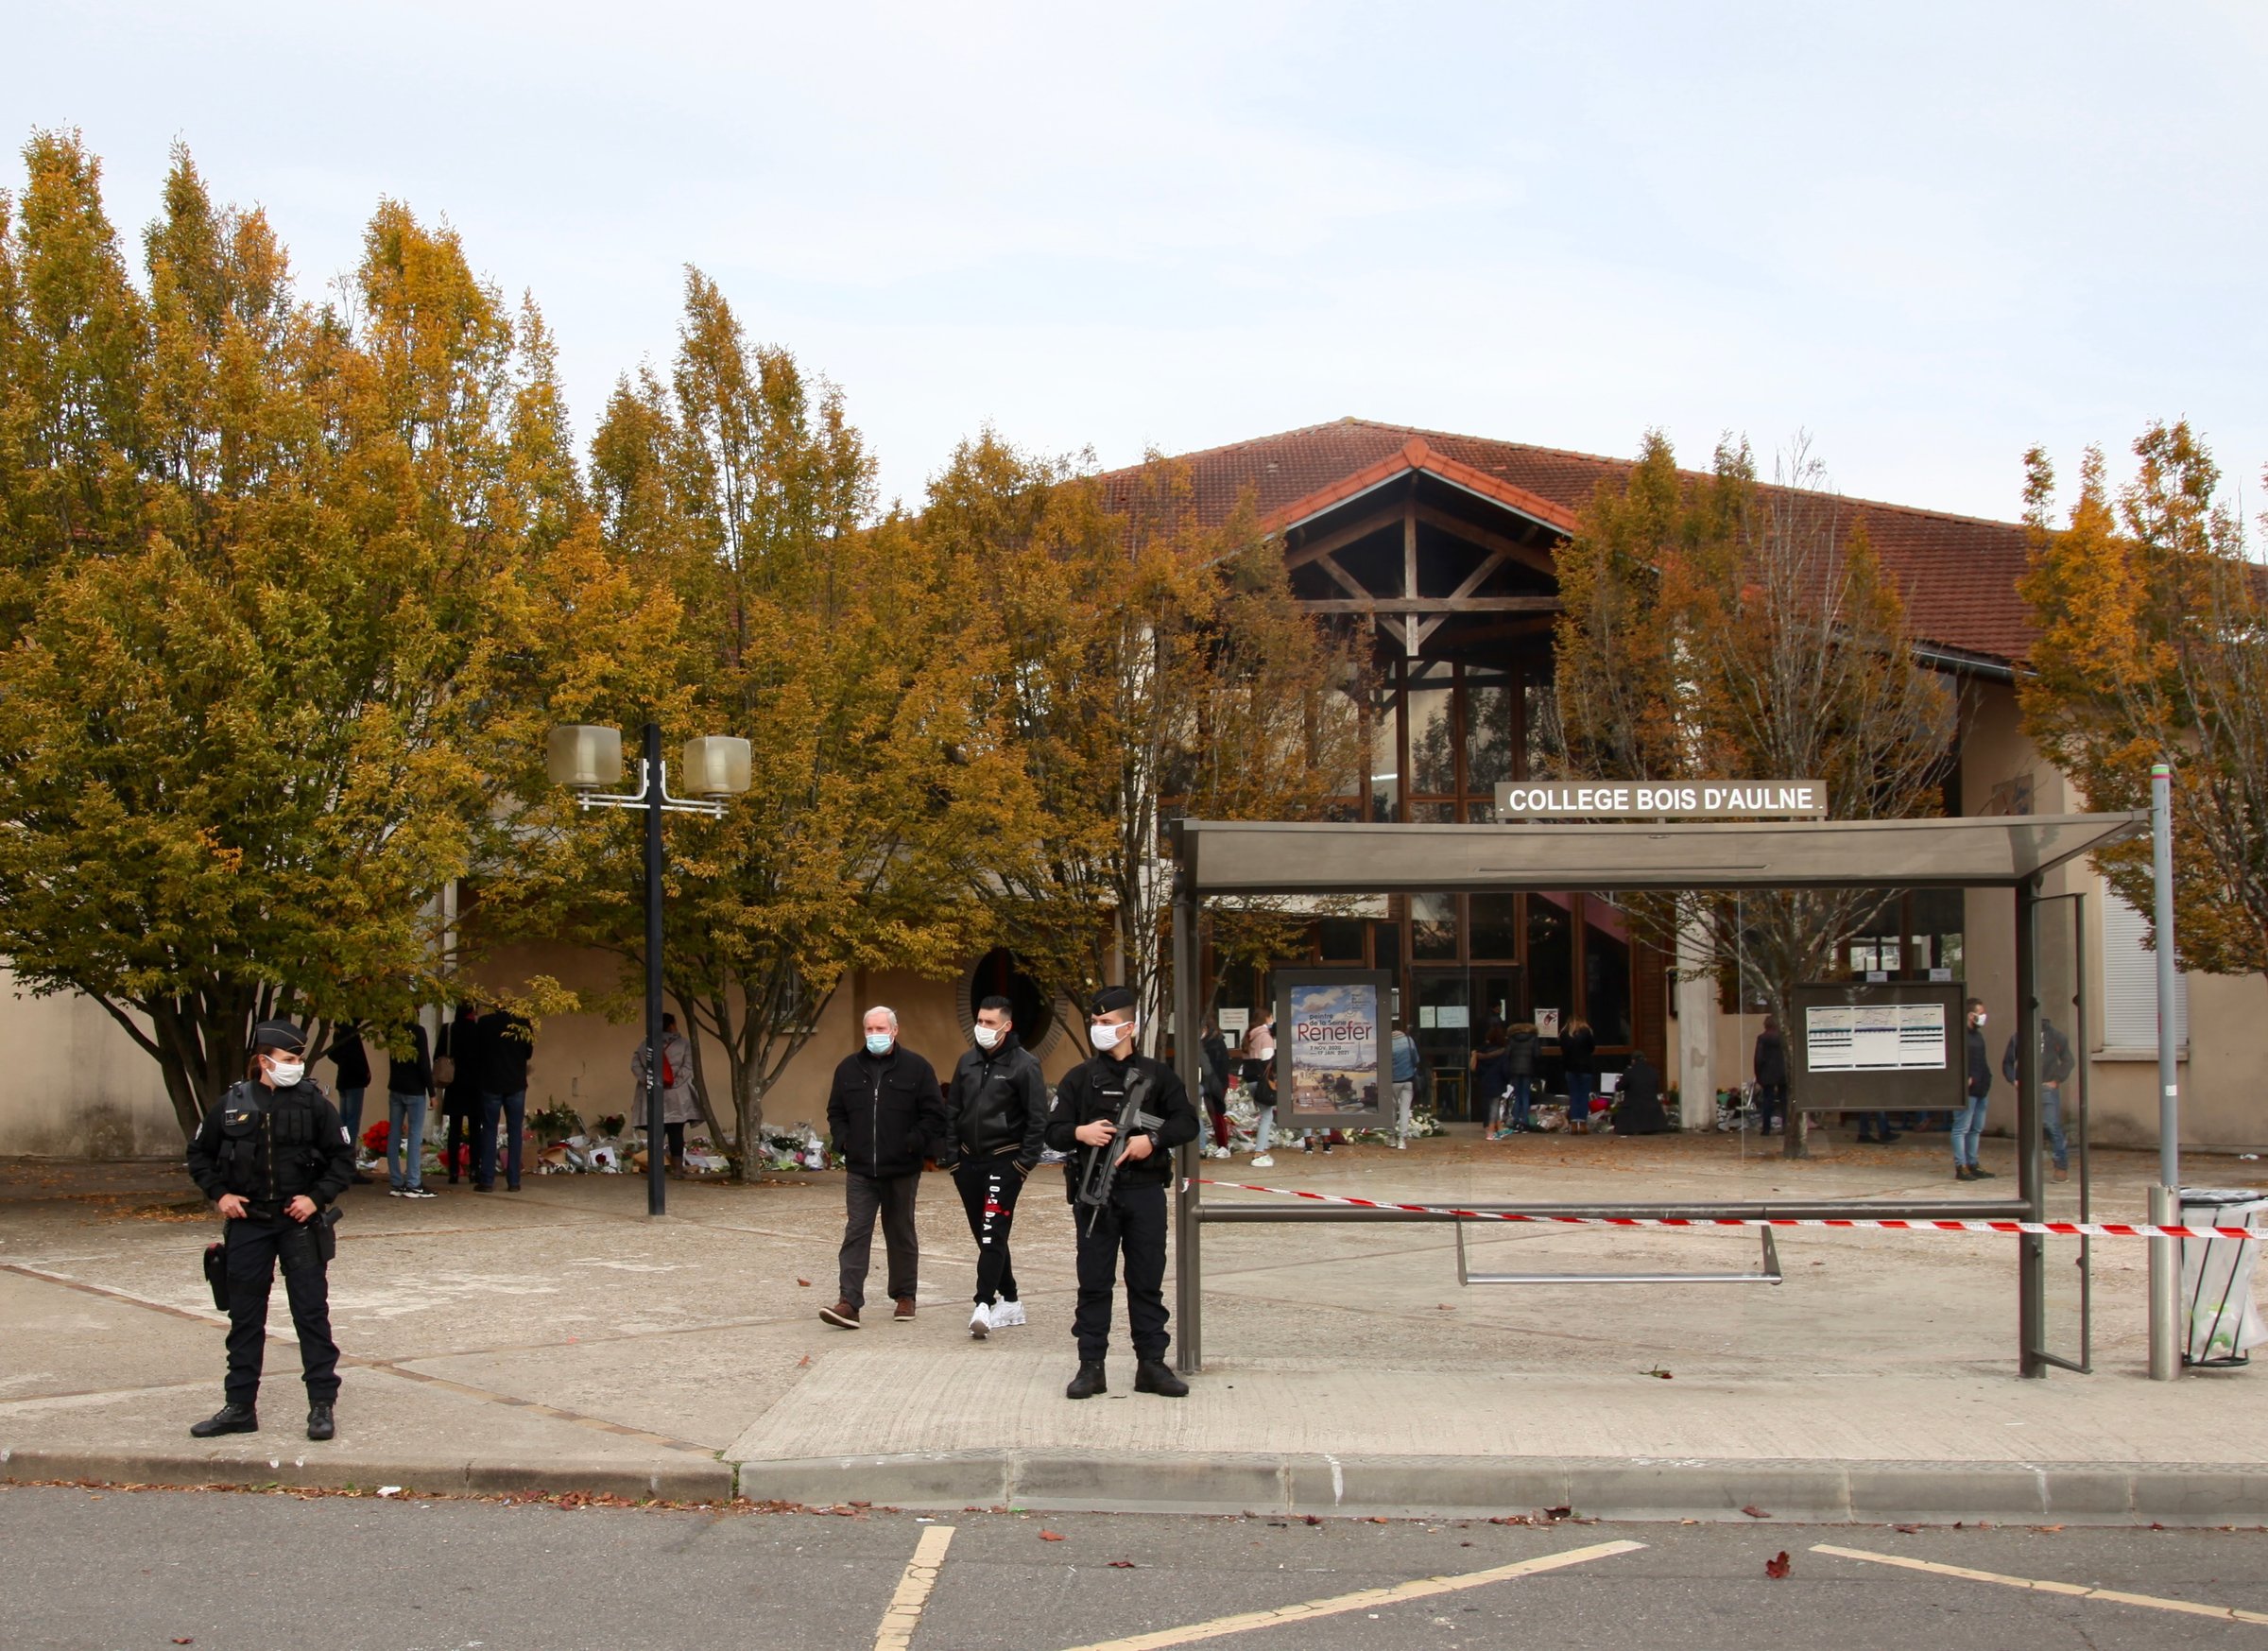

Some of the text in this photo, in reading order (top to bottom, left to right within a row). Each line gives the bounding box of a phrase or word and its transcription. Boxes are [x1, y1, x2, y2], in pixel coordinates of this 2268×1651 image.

[1509, 787, 1813, 811] COLLEGE BOIS D'AULNE
[1297, 1021, 1372, 1041] Renefer
